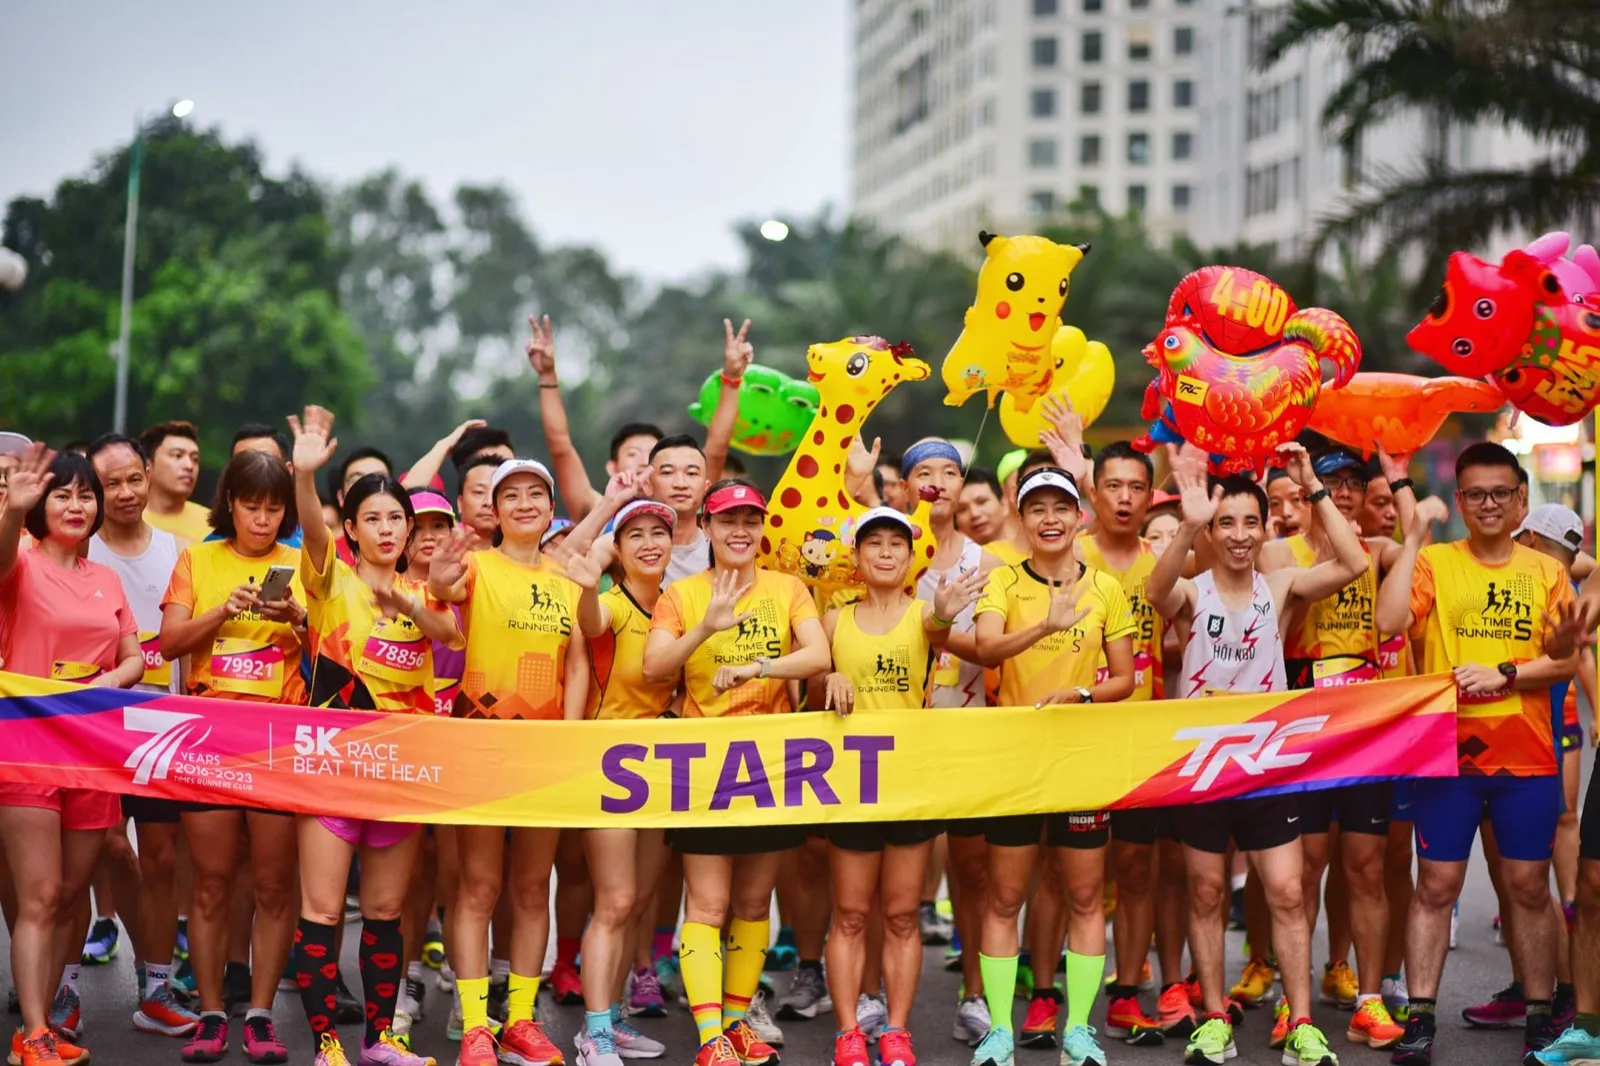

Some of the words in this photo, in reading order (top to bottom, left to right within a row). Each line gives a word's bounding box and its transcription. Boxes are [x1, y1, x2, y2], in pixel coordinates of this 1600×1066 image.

[1179, 381, 1202, 395] TRC
[376, 641, 425, 668] 78856
[222, 656, 274, 678] 79921
[293, 724, 342, 757] 5K
[347, 741, 399, 761] RACE
[1172, 715, 1330, 792] TRC
[181, 752, 220, 766] YEARS
[293, 757, 344, 776] BEAT
[351, 761, 386, 780] THE
[391, 764, 443, 783] HEAT
[174, 775, 195, 784] TIMES
[197, 778, 231, 789] RUNNERS
[233, 783, 253, 791] CLUB
[175, 762, 253, 783] 2016-2023
[601, 735, 894, 813] START
